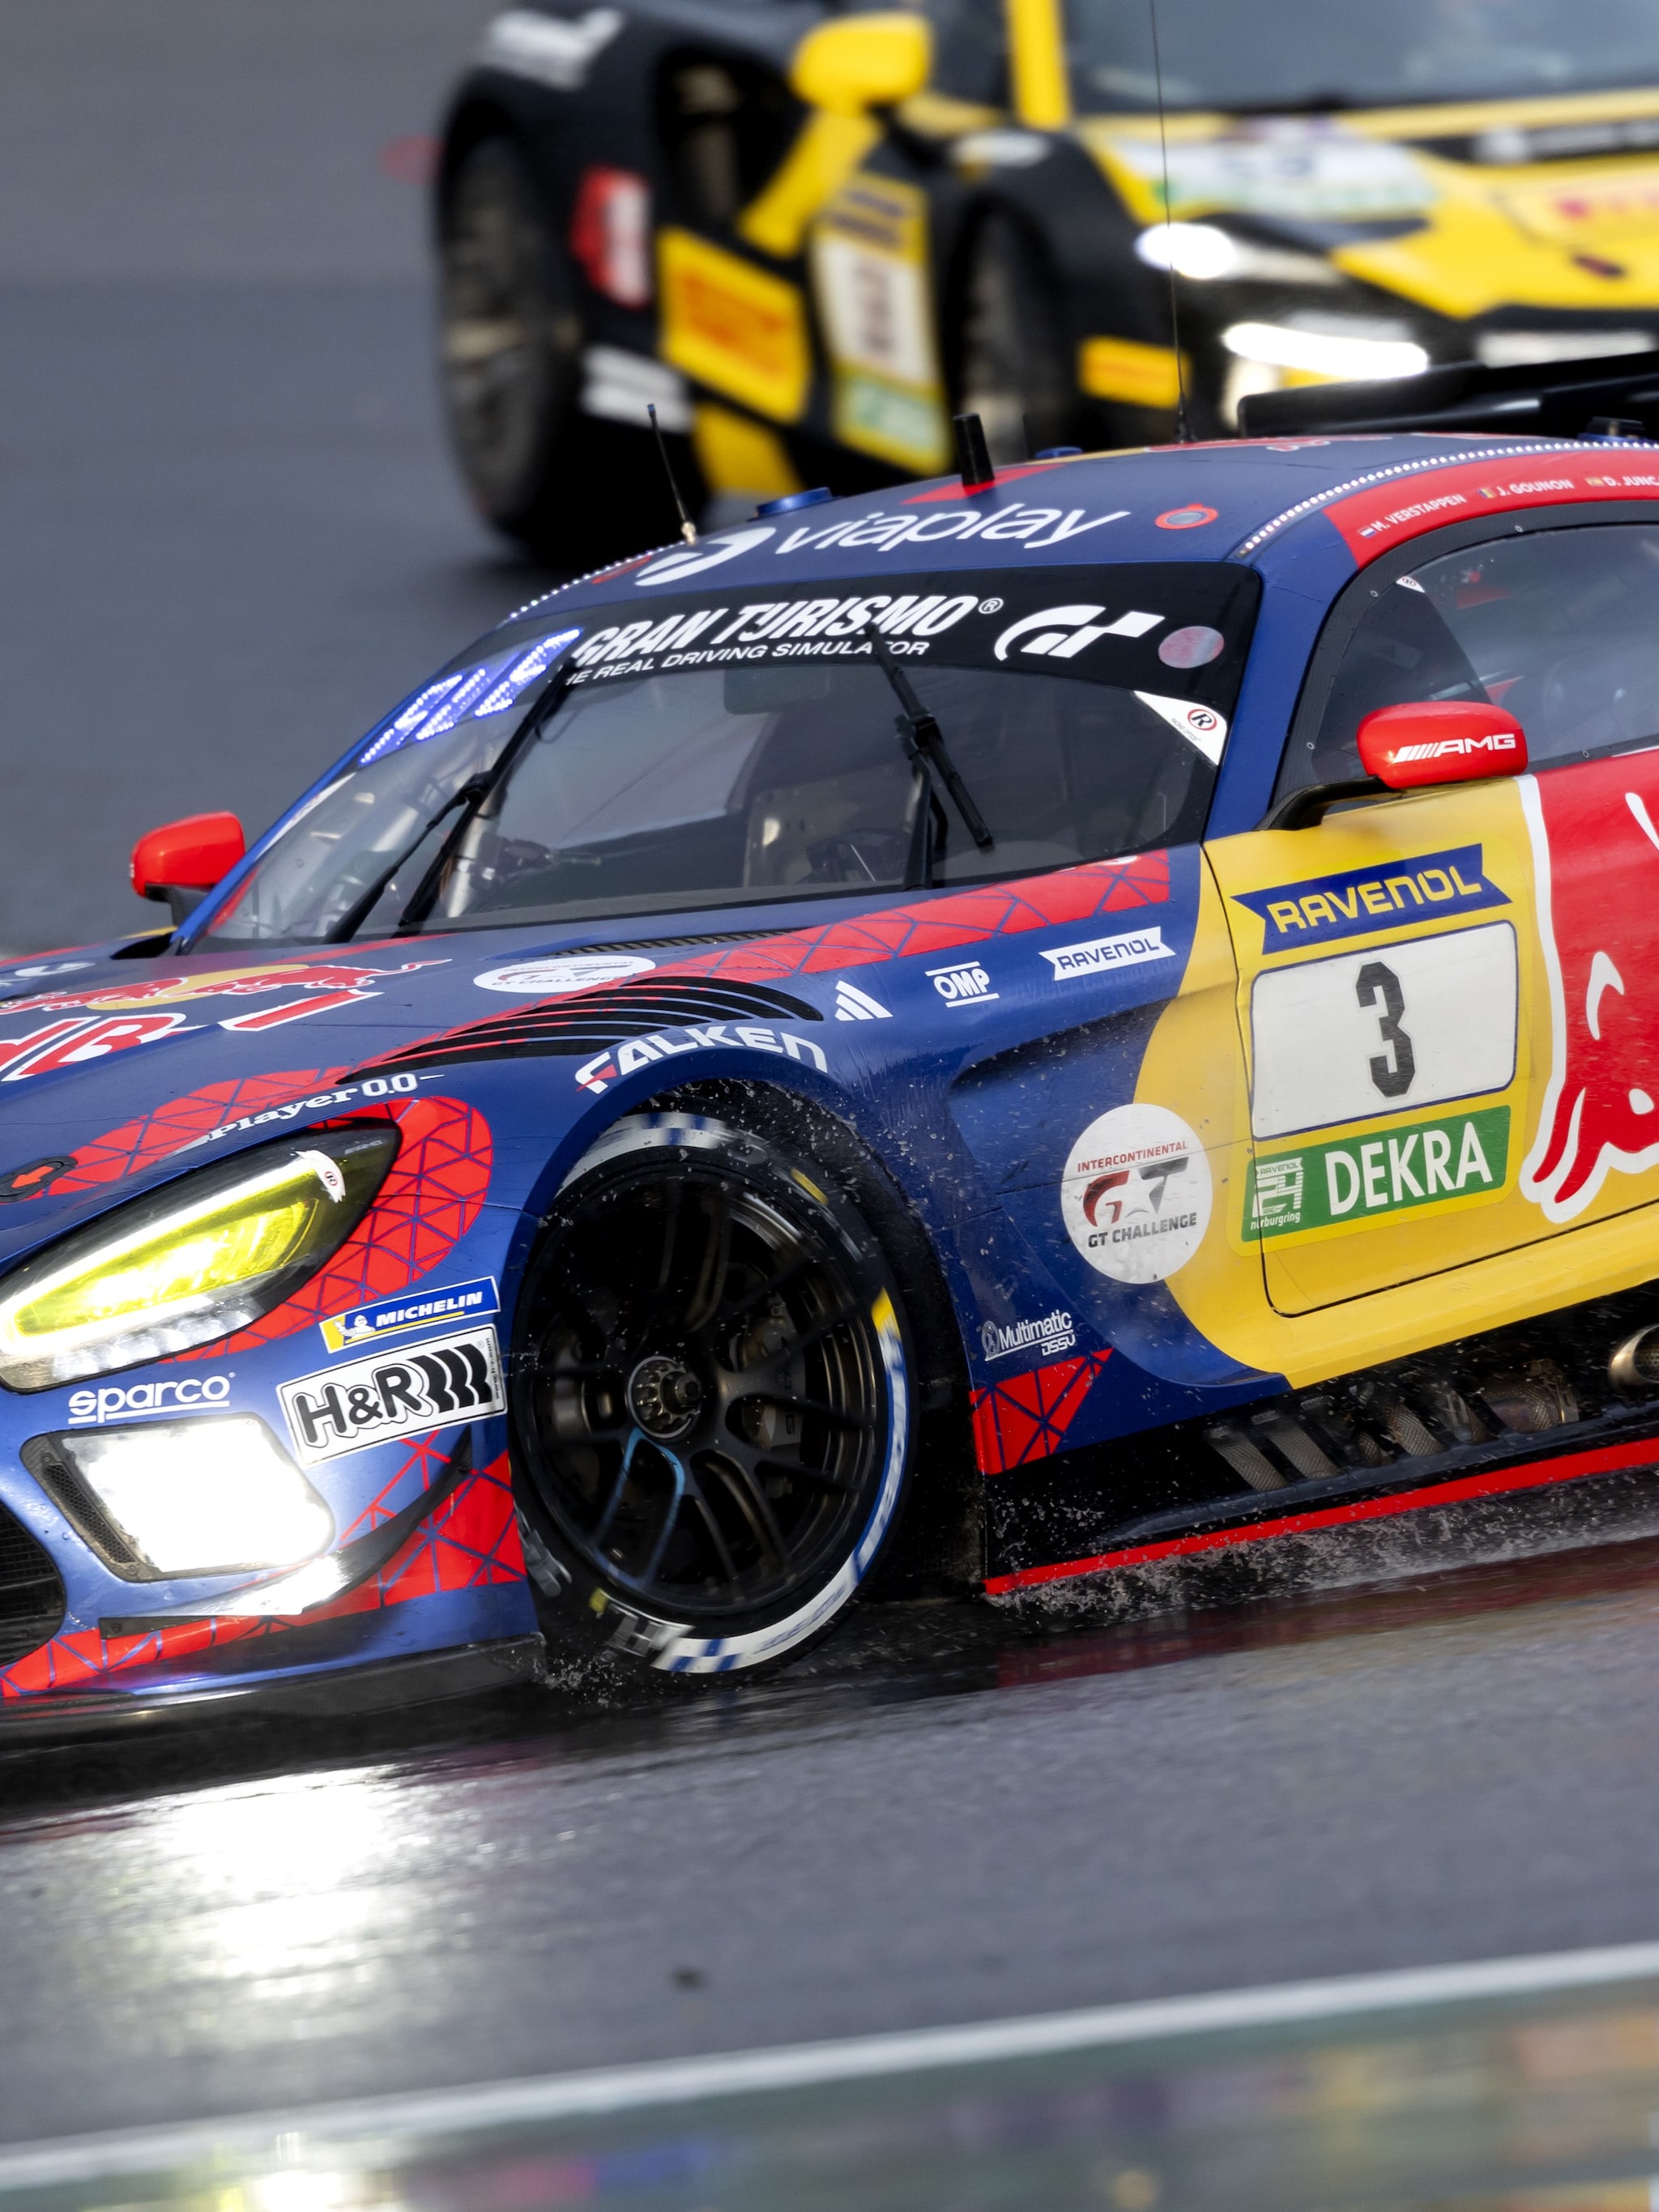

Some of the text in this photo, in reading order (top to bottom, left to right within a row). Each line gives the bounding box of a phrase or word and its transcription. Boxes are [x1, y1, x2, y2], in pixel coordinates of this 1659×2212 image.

[1370, 475, 1659, 532] M. VERSTAPPEN J. GOUNON D. JUNC
[775, 503, 1131, 554] viaplay
[570, 607, 730, 668] GRAN
[592, 657, 655, 680] REAL
[660, 645, 769, 668] DRIVING
[771, 641, 931, 658] SIMULAOR
[1434, 733, 1516, 757] AMG
[1265, 866, 1483, 934] RAVENOL
[1056, 938, 1160, 971] RAVENOL
[933, 968, 991, 999] OMP
[1354, 961, 1416, 1098] 3
[574, 1025, 828, 1095] FALKEN
[210, 1072, 419, 1141] Player 0.0
[1077, 1140, 1188, 1173] INTERCONTINENTAL
[1260, 1162, 1299, 1176] RAVENOL
[1324, 1120, 1494, 1217] DEKRA
[1087, 1212, 1198, 1248] GT CHALLENGE
[375, 1291, 484, 1328] MICHELIN
[998, 1309, 1073, 1350] Multimatic
[68, 1375, 231, 1424] sparco
[295, 1366, 422, 1443] H&R
